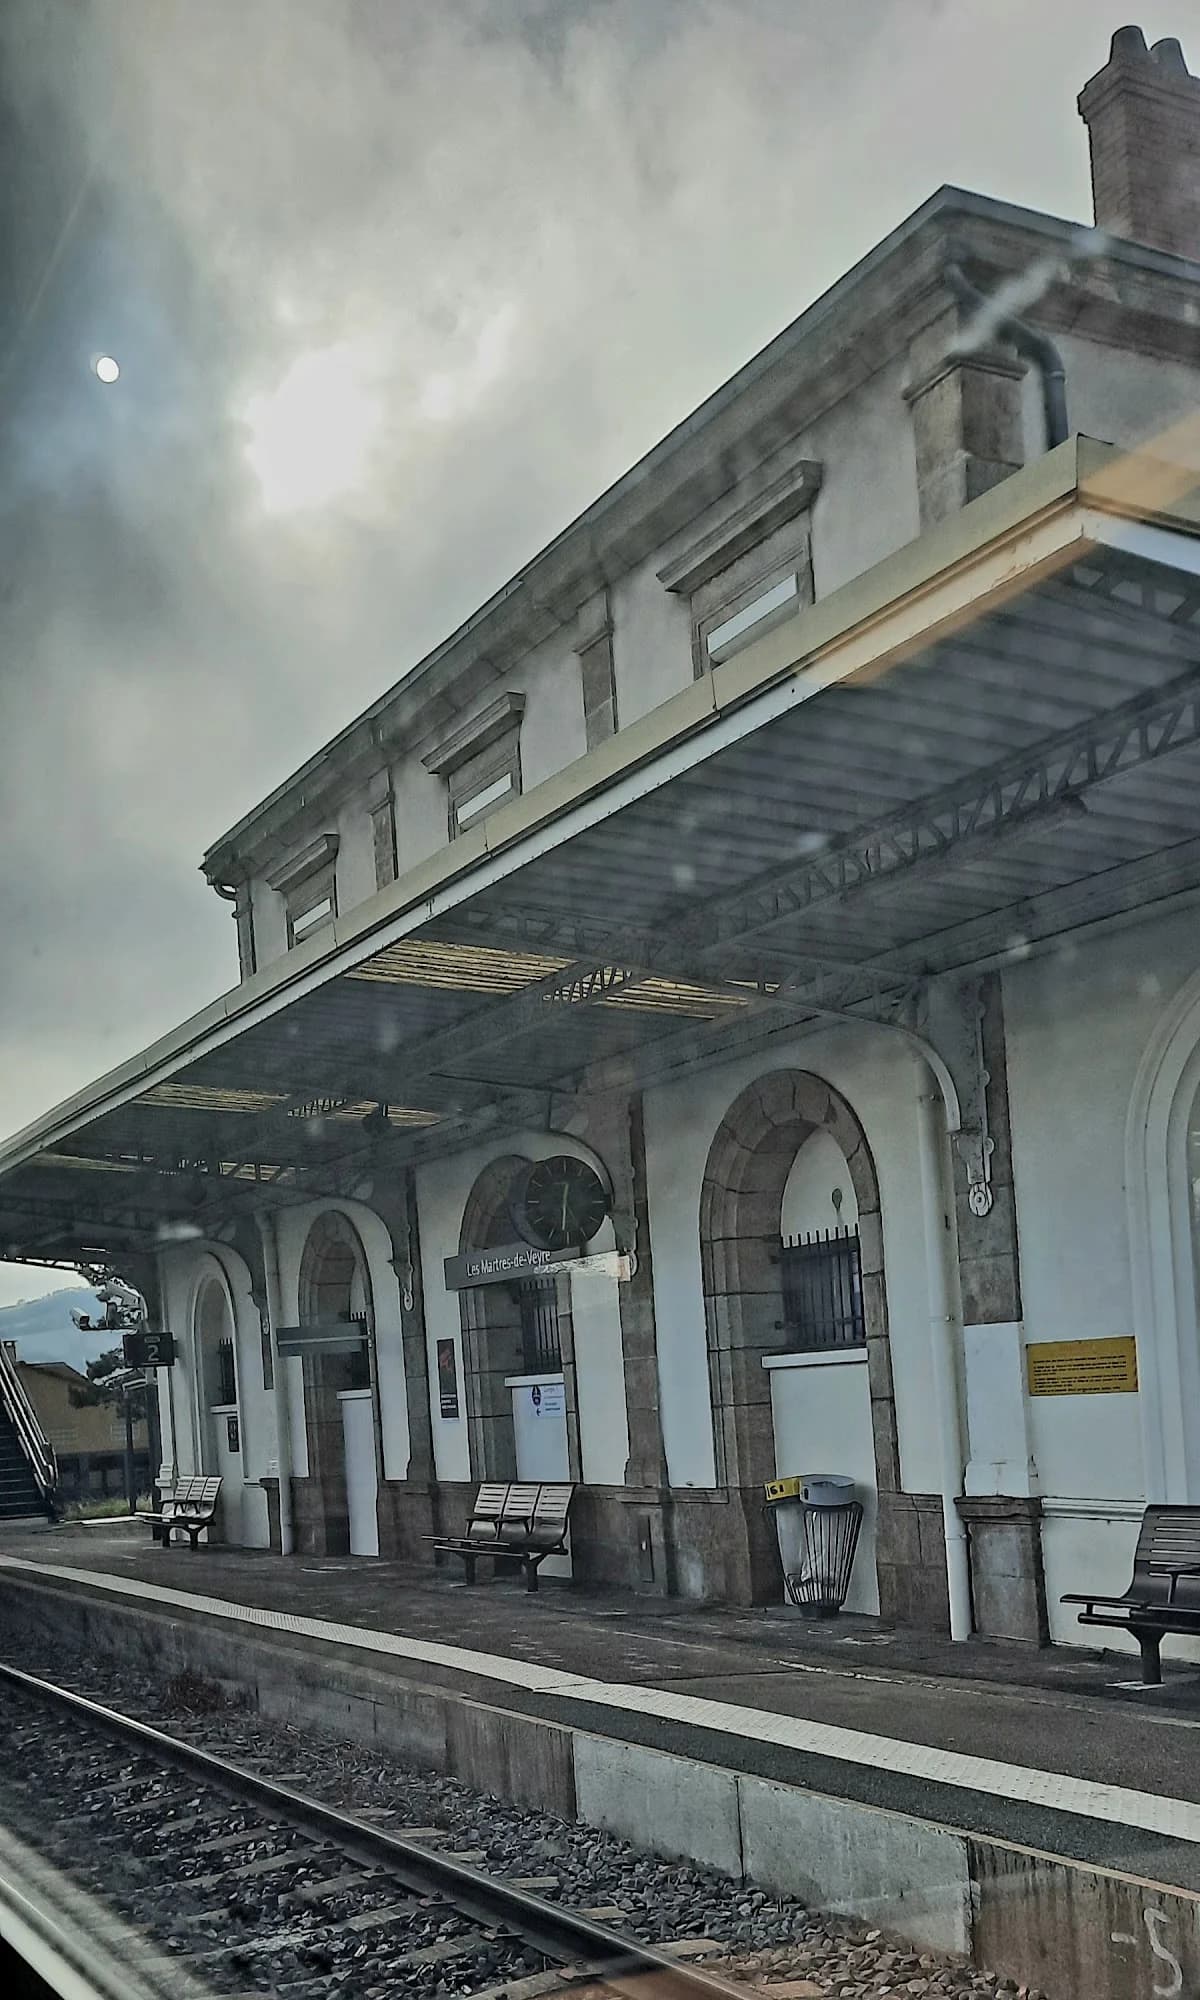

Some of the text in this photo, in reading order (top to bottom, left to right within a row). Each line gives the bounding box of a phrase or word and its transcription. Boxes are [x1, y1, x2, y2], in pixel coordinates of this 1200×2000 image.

[466, 1248, 551, 1277] Les Martres-de-Veyre
[147, 1344, 160, 1362] 2
